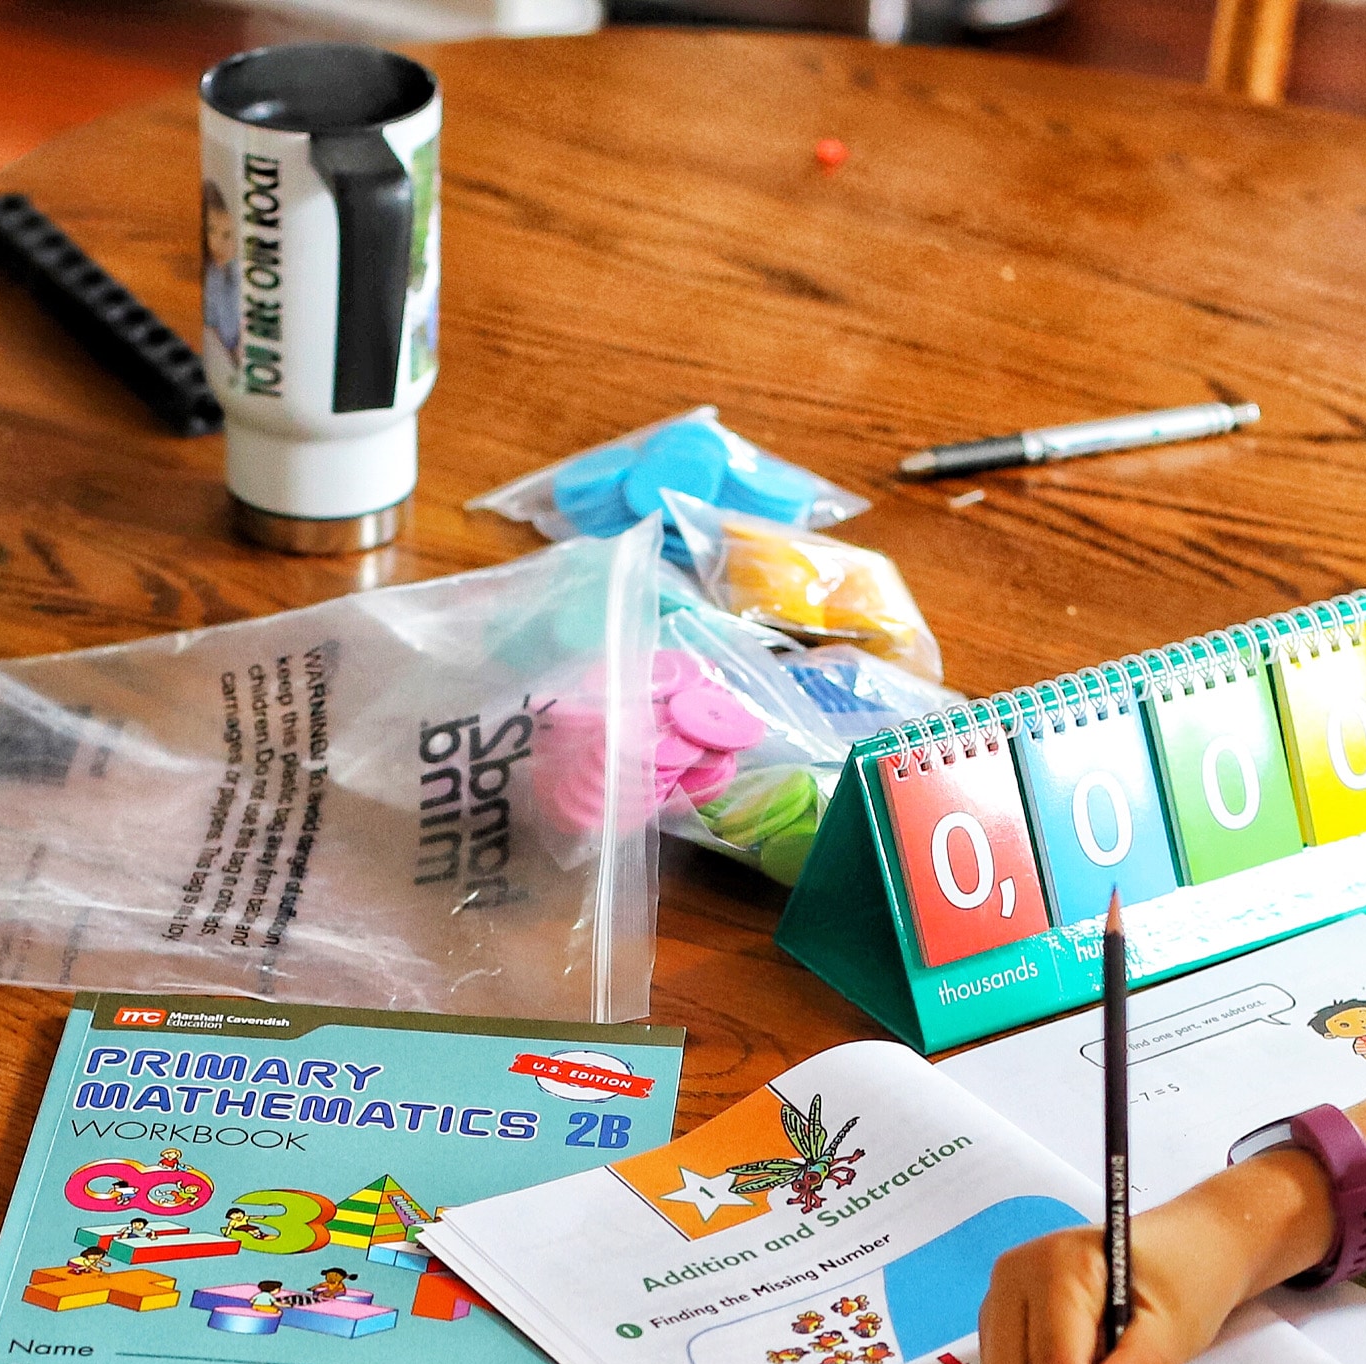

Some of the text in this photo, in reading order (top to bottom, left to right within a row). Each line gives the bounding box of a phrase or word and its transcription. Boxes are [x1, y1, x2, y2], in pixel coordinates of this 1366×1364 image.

[276, 655, 294, 706] keep
[282, 712, 298, 748] this
[255, 748, 274, 776] Do
[278, 752, 298, 803] plastic
[266, 807, 293, 831] bag
[221, 851, 249, 874] bag
[257, 835, 283, 867] away
[183, 872, 211, 894] bag
[253, 868, 277, 895] from
[231, 924, 250, 947] and
[938, 956, 1039, 1006] thousands
[166, 1018, 223, 1030] Education
[169, 1011, 225, 1023] Marshall
[226, 1015, 290, 1027] Cavendish
[1152, 1032, 1173, 1043] one
[1202, 1015, 1219, 1026] we
[84, 1046, 383, 1092] PRIMARY
[532, 1061, 632, 1089] U.S. EDITION
[73, 1081, 632, 1149] MATHEMATICS 2B
[71, 1119, 310, 1152] WORKBOOK
[642, 1133, 974, 1293] Addition and Subtraction
[649, 1302, 720, 1330] Finding
[719, 1291, 752, 1308] the
[751, 1267, 820, 1298] Missing
[818, 1232, 892, 1273] Number
[8, 1339, 94, 1357] Name
